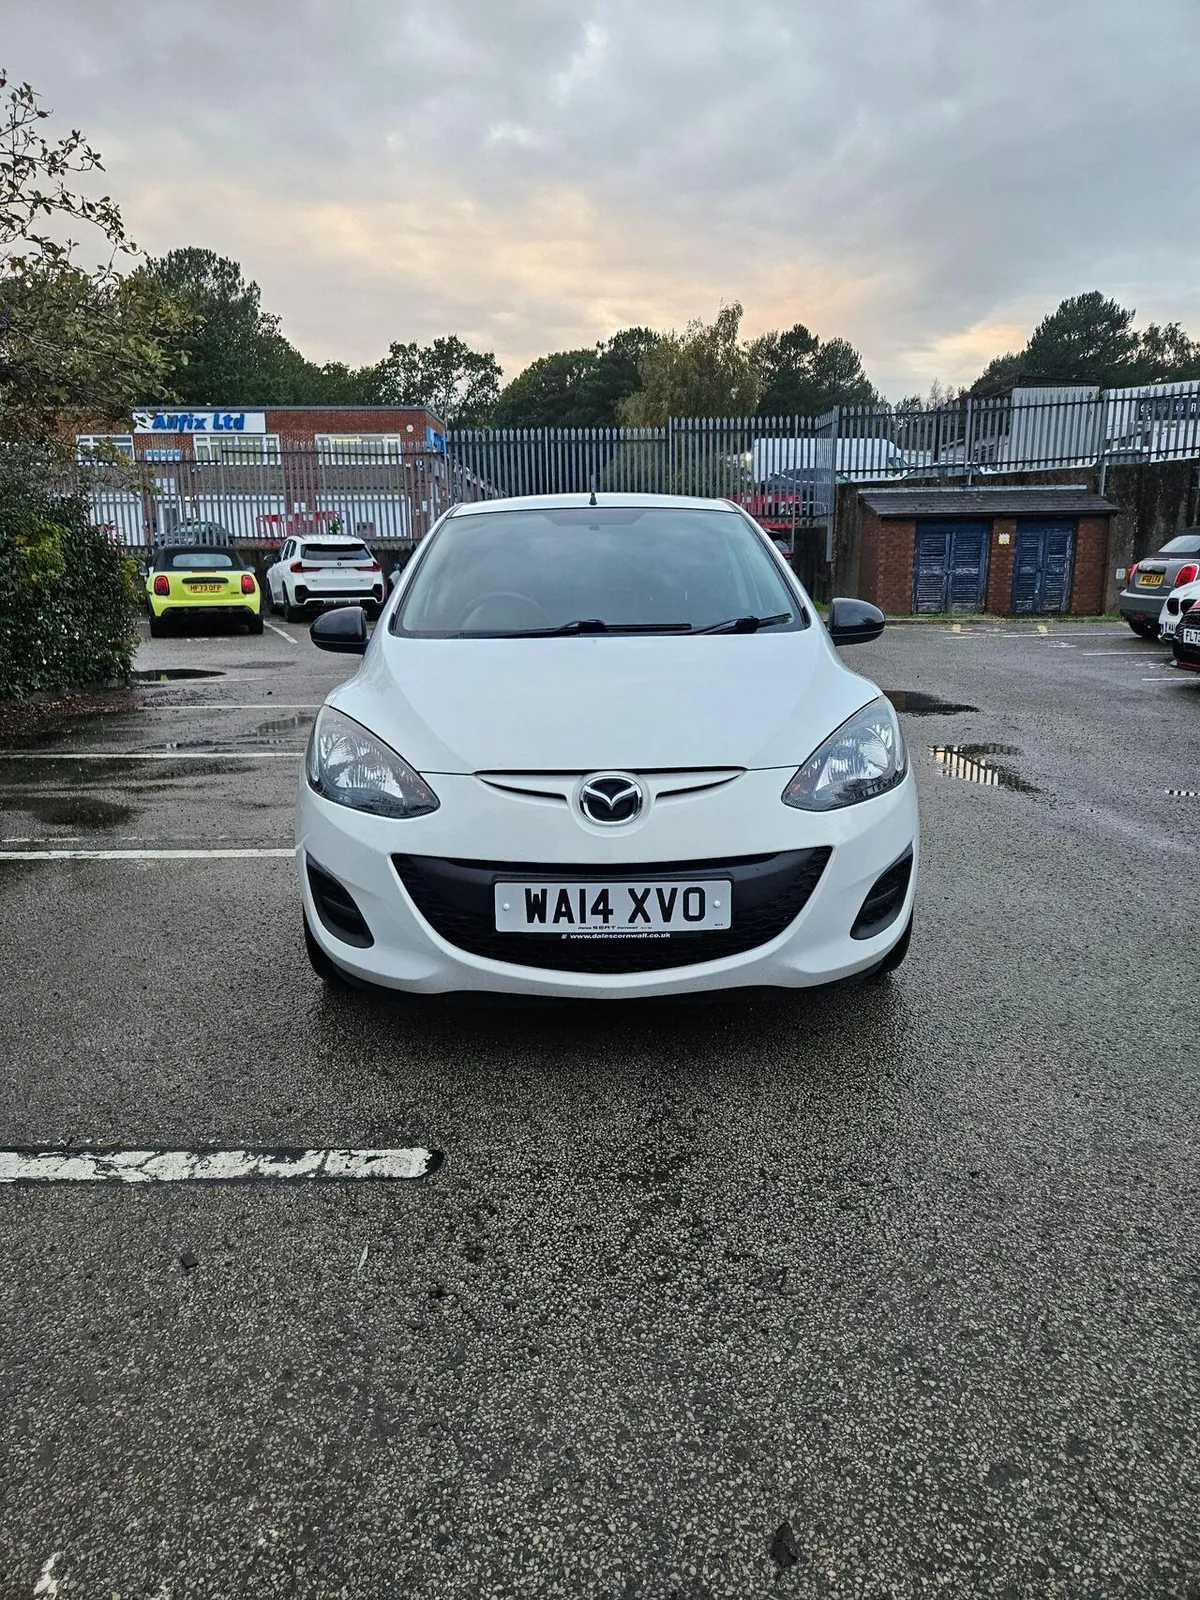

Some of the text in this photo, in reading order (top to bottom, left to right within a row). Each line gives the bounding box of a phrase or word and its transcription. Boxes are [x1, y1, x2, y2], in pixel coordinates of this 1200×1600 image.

[152, 412, 246, 432] Allfix Ltd
[524, 886, 706, 924] WA14 XVO
[569, 932, 671, 940] www.dalescornwall.co.uk
